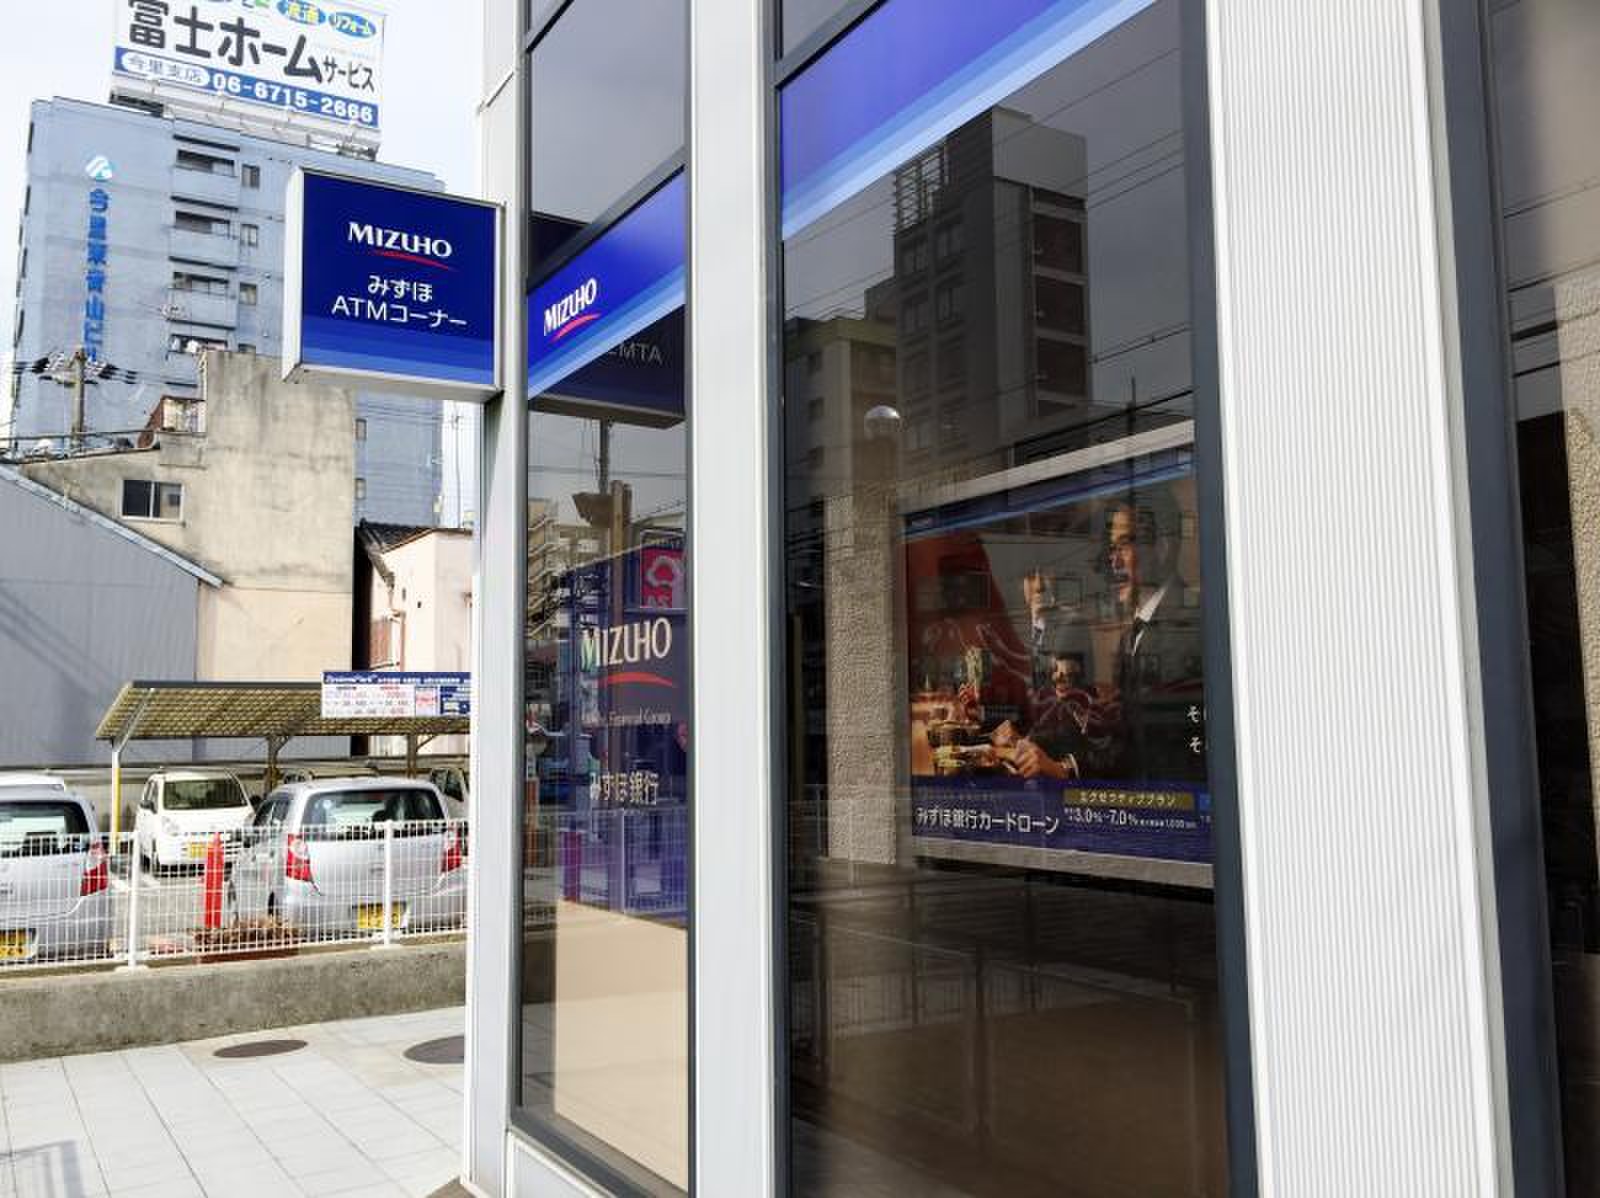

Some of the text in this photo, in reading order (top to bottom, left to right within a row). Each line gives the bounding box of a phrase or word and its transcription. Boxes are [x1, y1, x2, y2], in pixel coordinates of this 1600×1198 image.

[212, 72, 373, 122] 06-6715-2666
[347, 221, 453, 259] MIZUHO
[367, 274, 433, 301] みずほ
[331, 295, 468, 329] ATMコーナー
[543, 277, 598, 336] MIZUHO
[580, 616, 673, 673] MIZUHO
[589, 770, 659, 806] みずほ銀行
[915, 804, 1060, 835] みずほ銀行カードローン
